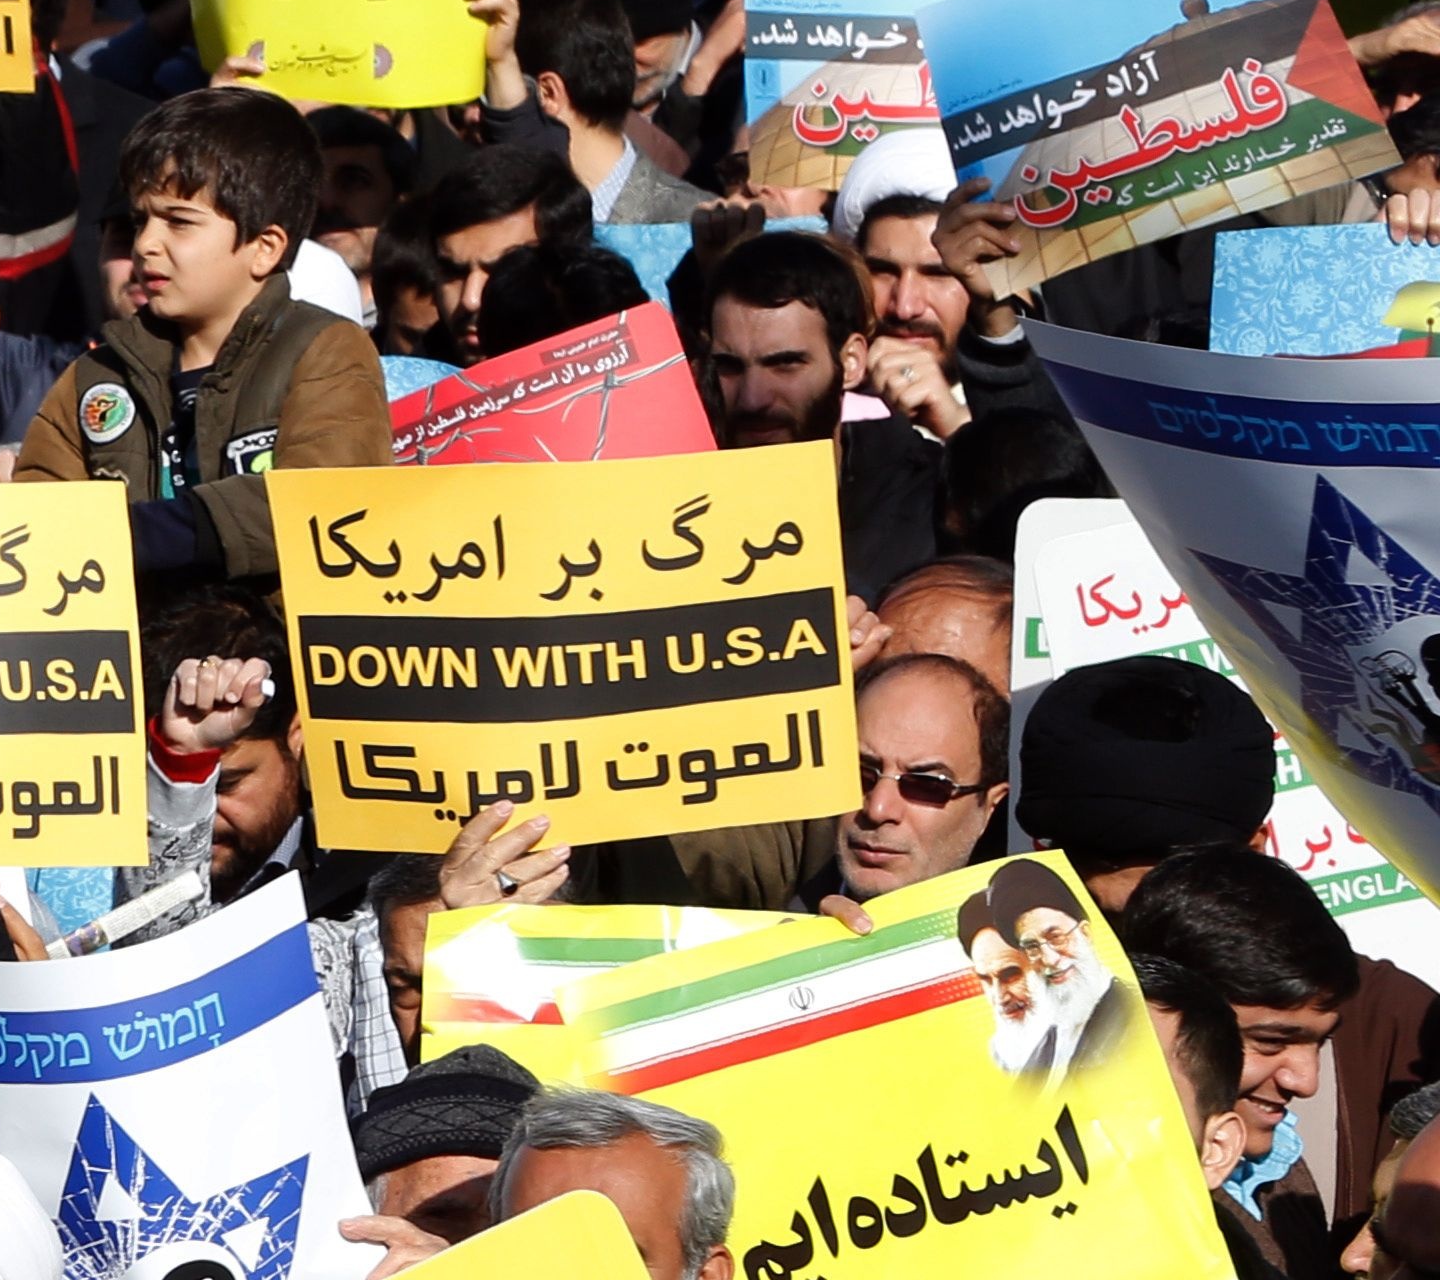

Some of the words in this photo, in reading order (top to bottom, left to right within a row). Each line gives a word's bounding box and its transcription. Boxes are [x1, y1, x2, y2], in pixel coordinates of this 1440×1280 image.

[1107, 52, 1160, 100] آزاد
[997, 79, 1097, 141] خواهد
[1014, 57, 1288, 228] فلسطین
[1304, 121, 1347, 150] تقدیر
[1189, 161, 1218, 189] این
[1221, 140, 1295, 177] خداوند
[1115, 183, 1136, 206] که
[1144, 174, 1185, 195] است
[308, 642, 478, 686] DOWN
[496, 640, 646, 686] WITH
[665, 617, 826, 673] U.S.A
[2, 658, 125, 700] U.S.A
